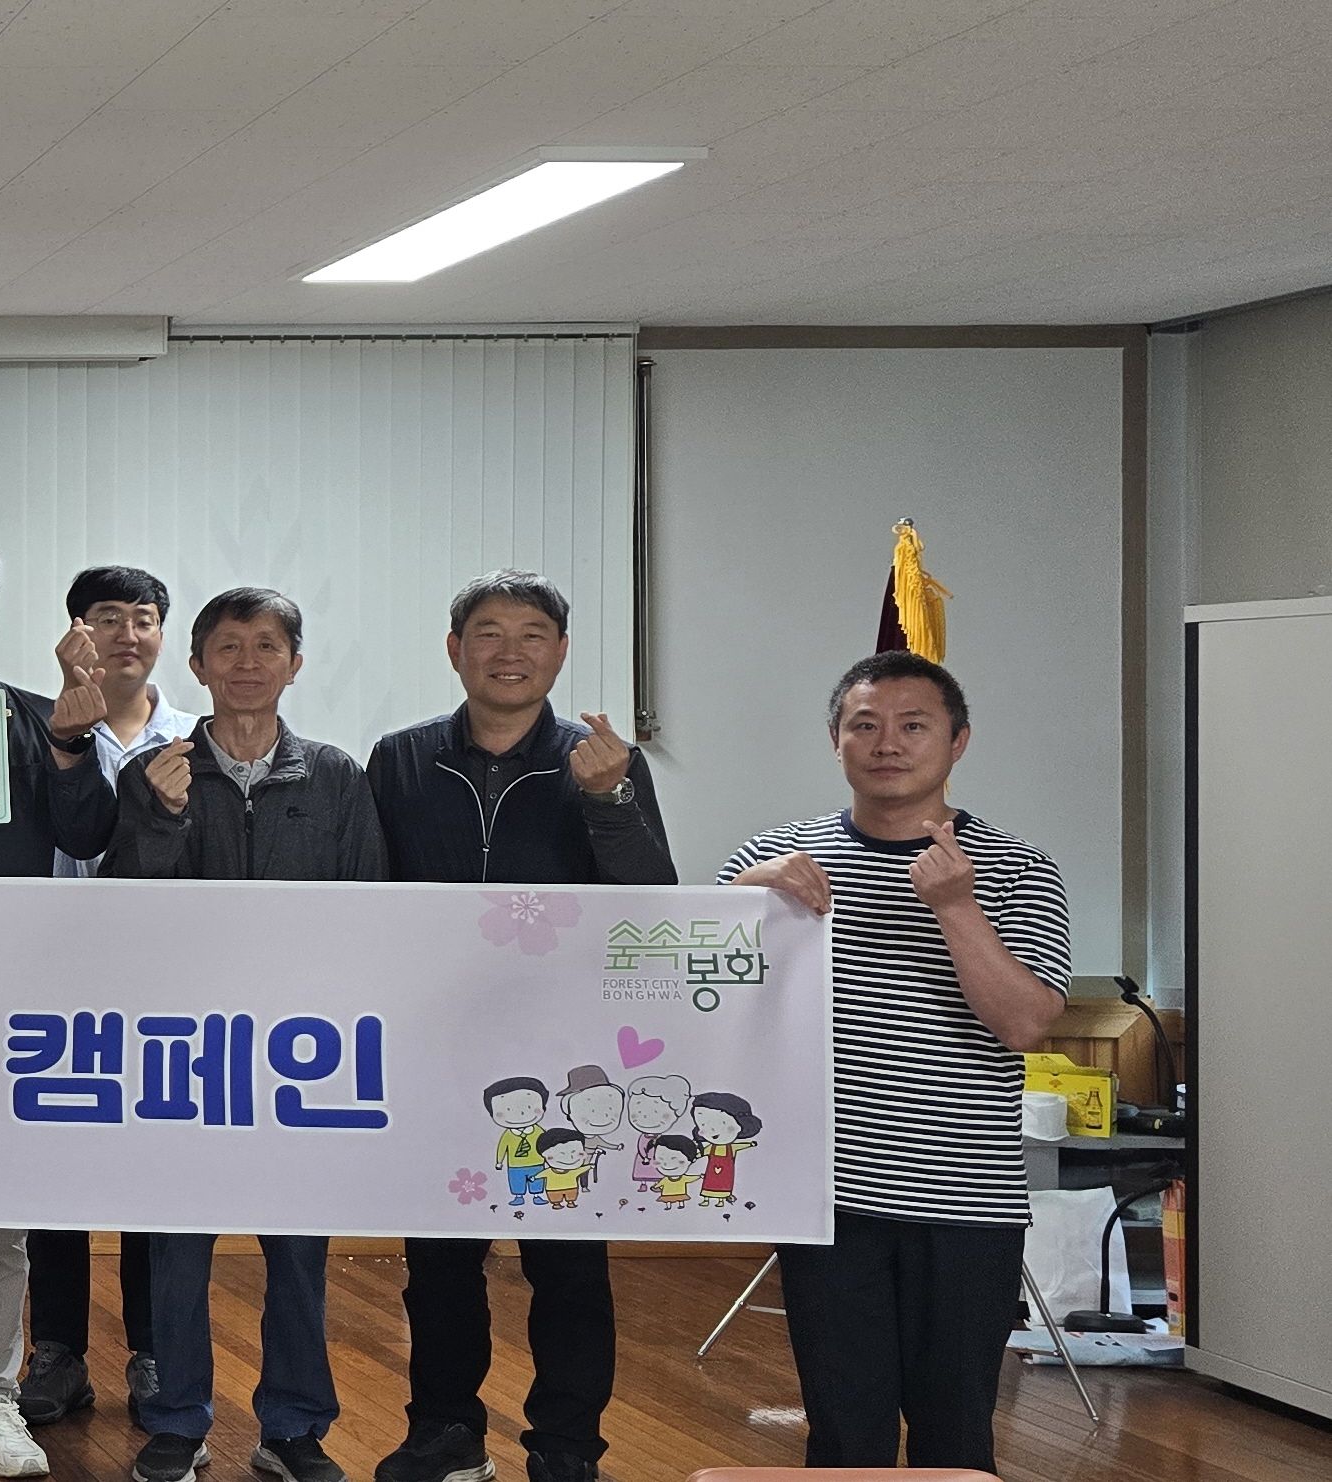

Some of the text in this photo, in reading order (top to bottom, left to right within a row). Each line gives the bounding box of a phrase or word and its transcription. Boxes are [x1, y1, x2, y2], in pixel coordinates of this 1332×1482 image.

[603, 919, 763, 971] 숲속도시
[602, 978, 681, 989] FOREST CITY
[602, 990, 683, 1001] BONGHWA
[686, 947, 770, 1013] 봉화
[6, 1011, 389, 1130] 캠페인
